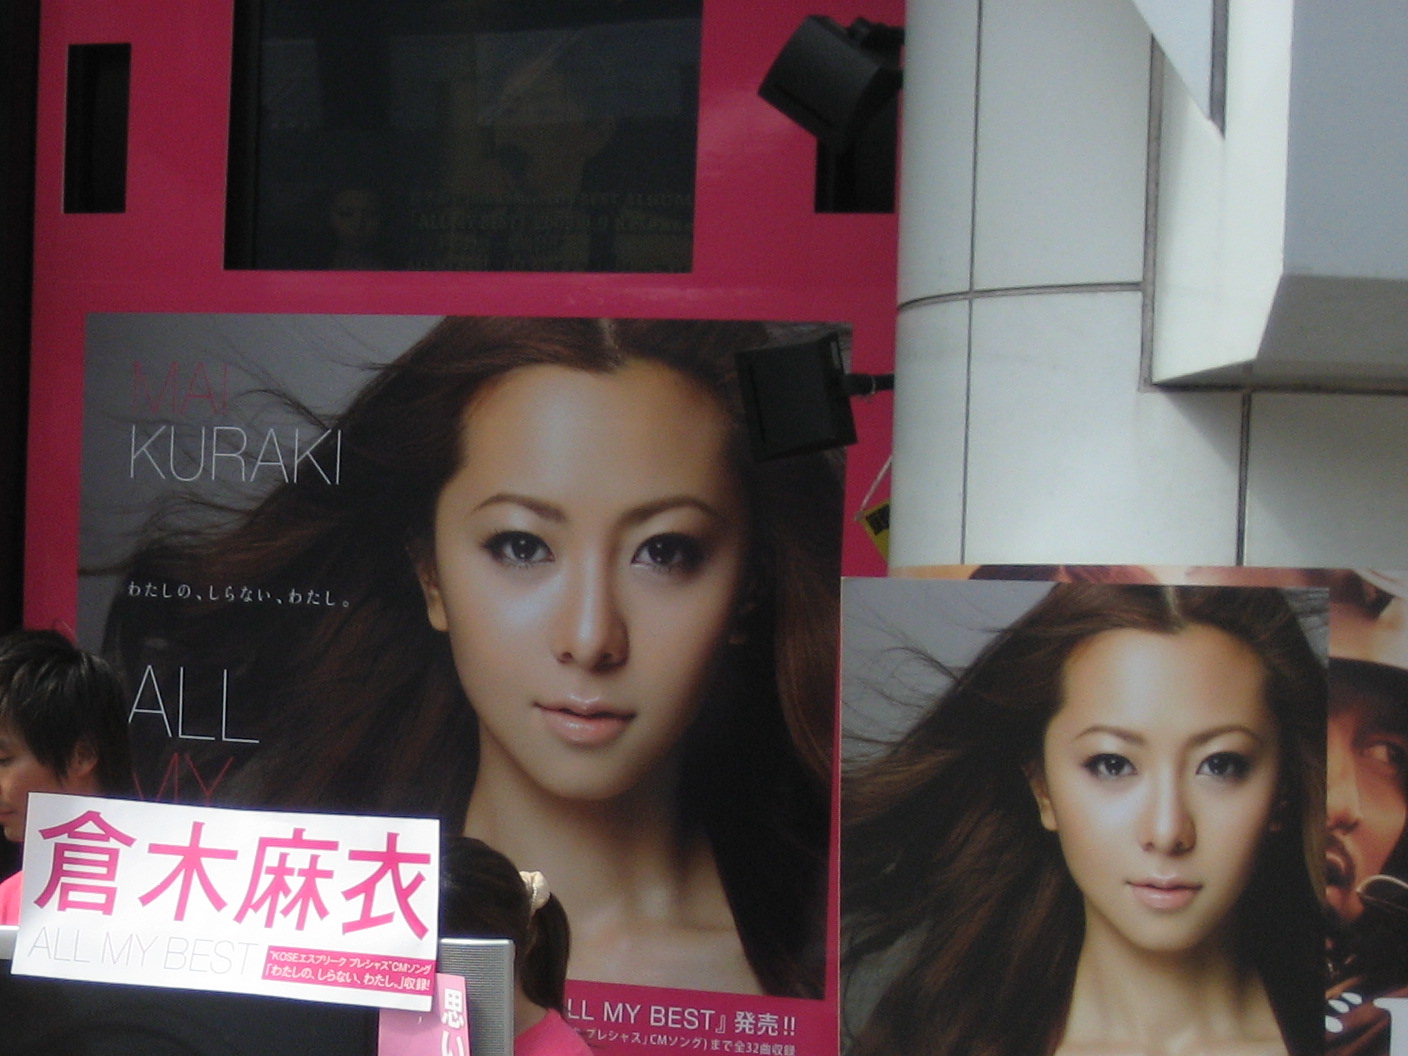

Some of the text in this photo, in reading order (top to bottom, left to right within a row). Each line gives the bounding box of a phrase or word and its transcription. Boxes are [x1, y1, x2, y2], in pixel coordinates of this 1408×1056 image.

[132, 361, 229, 416] MAI
[129, 424, 343, 486] KURAKI
[127, 580, 350, 608] わたしの、しらない、わたし。
[128, 664, 260, 744] ALL
[33, 809, 432, 942] 倉木麻衣
[28, 926, 259, 976] ALL MY BEST
[603, 1002, 641, 1024] MY
